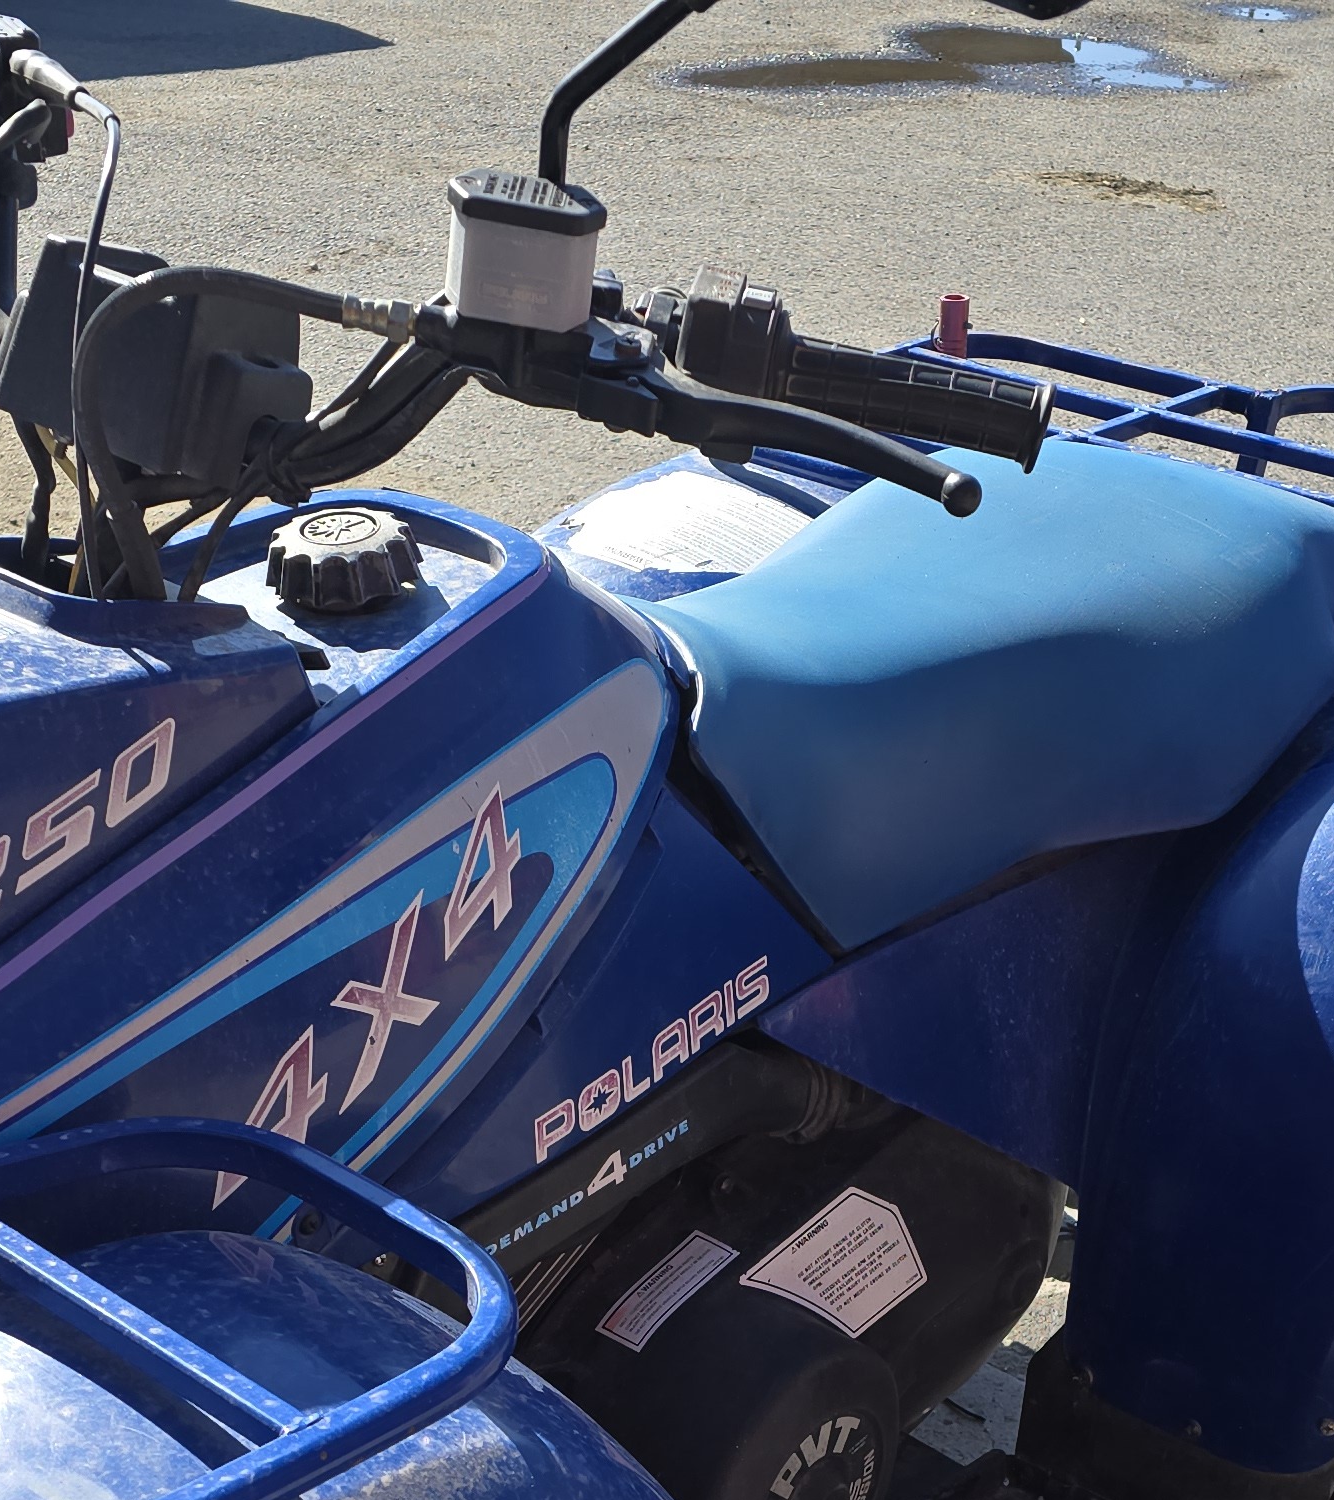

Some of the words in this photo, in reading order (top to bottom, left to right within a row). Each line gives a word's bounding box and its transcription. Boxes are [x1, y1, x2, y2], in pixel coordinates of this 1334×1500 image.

[212, 781, 522, 1211] 4X4
[534, 955, 769, 1164] POLARIS
[586, 1149, 628, 1197] 4
[629, 1119, 690, 1169] DRIVE
[795, 1219, 829, 1251] WARNING
[769, 1416, 861, 1500] PVT
